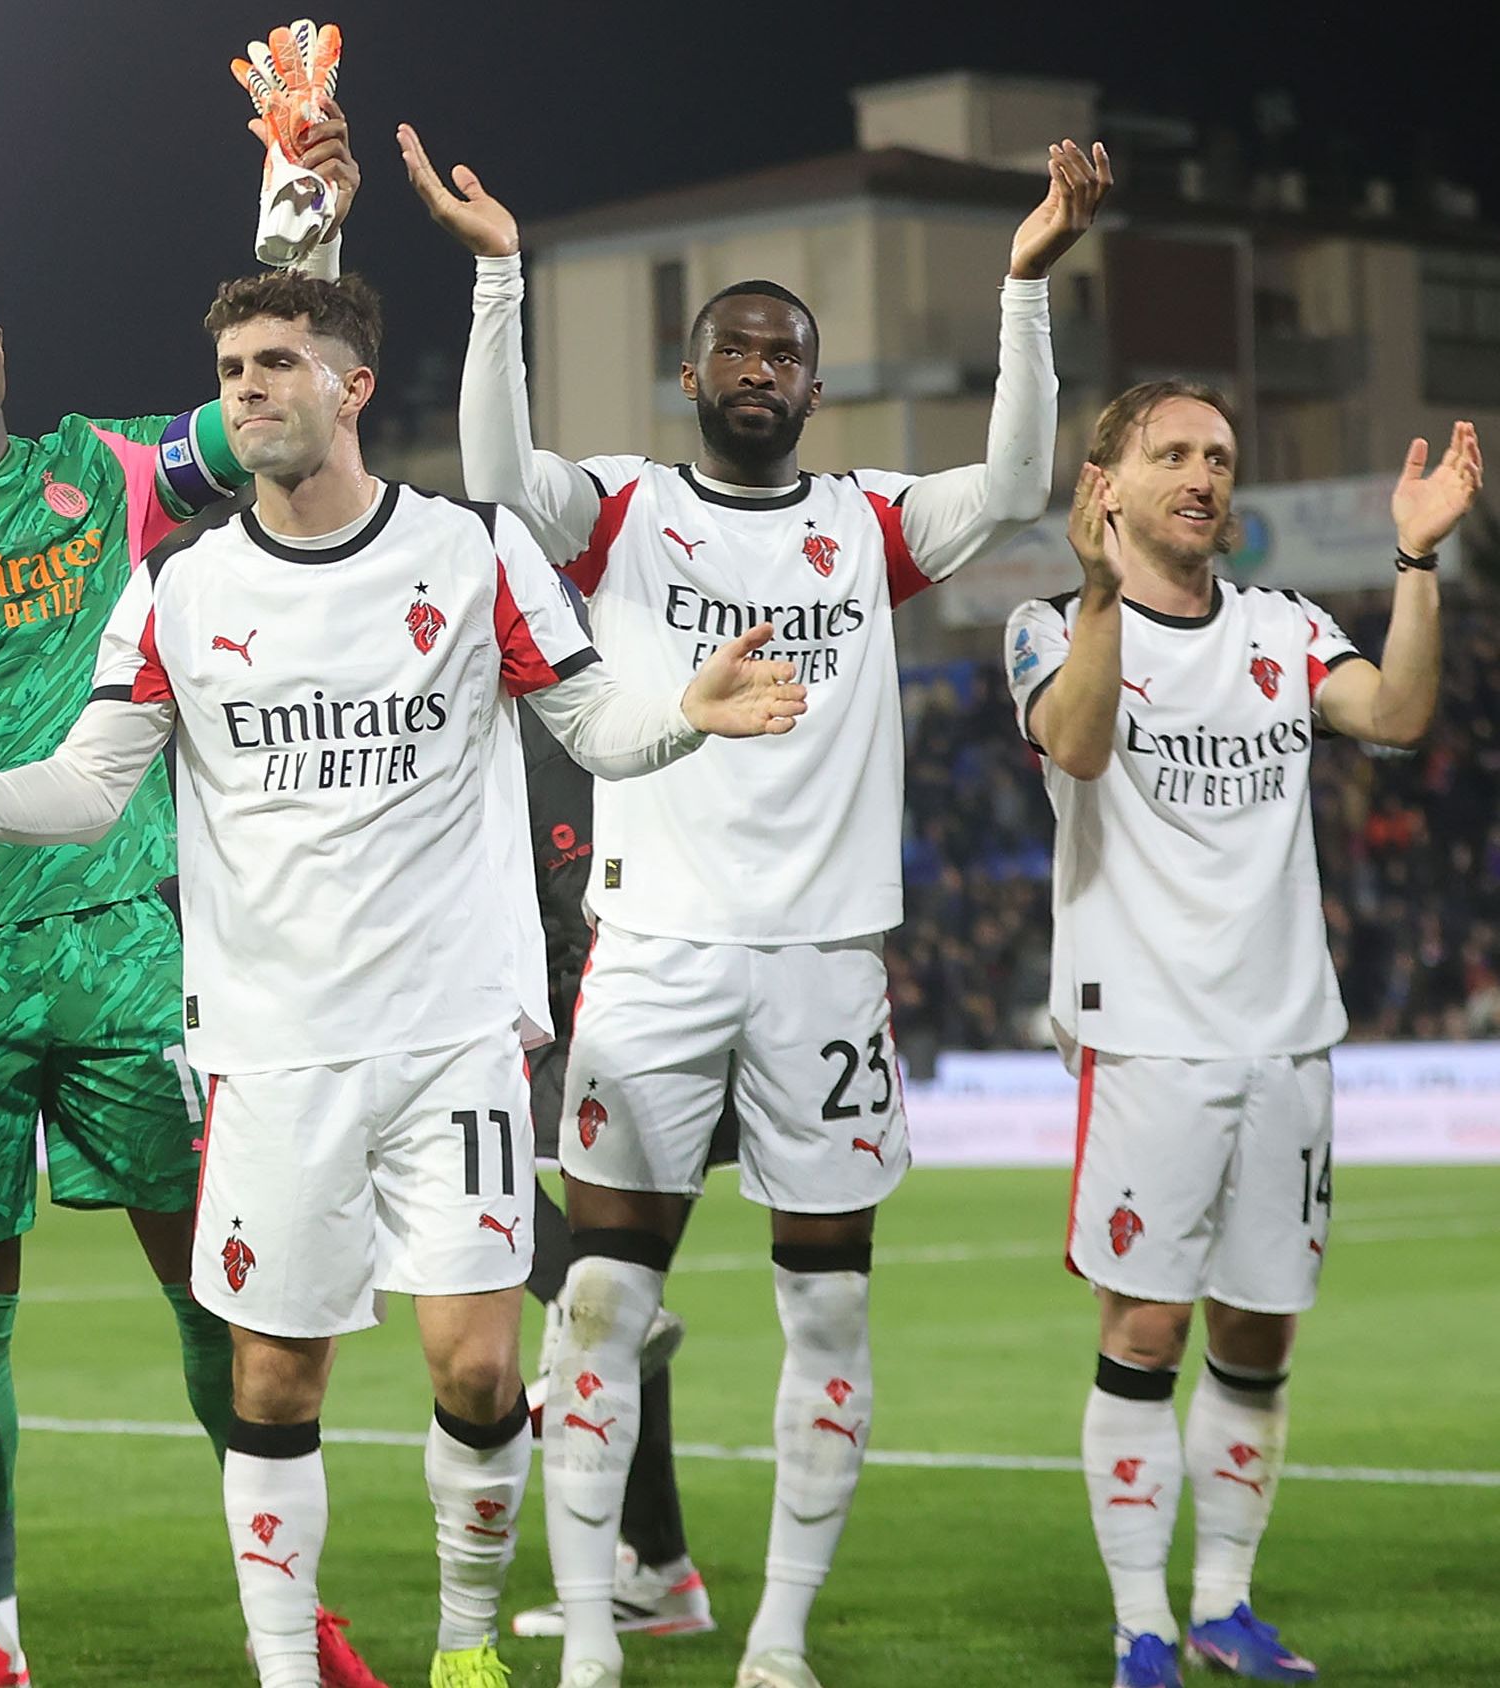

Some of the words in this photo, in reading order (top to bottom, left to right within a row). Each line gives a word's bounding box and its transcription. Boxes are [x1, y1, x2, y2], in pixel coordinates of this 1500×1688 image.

[666, 584, 865, 642] Emirates
[220, 690, 447, 749] Emirates
[1125, 710, 1310, 769] Emirates
[263, 752, 307, 791] FLY
[318, 744, 419, 789] BETTER
[1154, 767, 1196, 804] FLY
[1203, 766, 1286, 806] BETTER
[820, 1032, 891, 1121] 23
[451, 1109, 514, 1196] 11
[1301, 1142, 1332, 1224] 14
